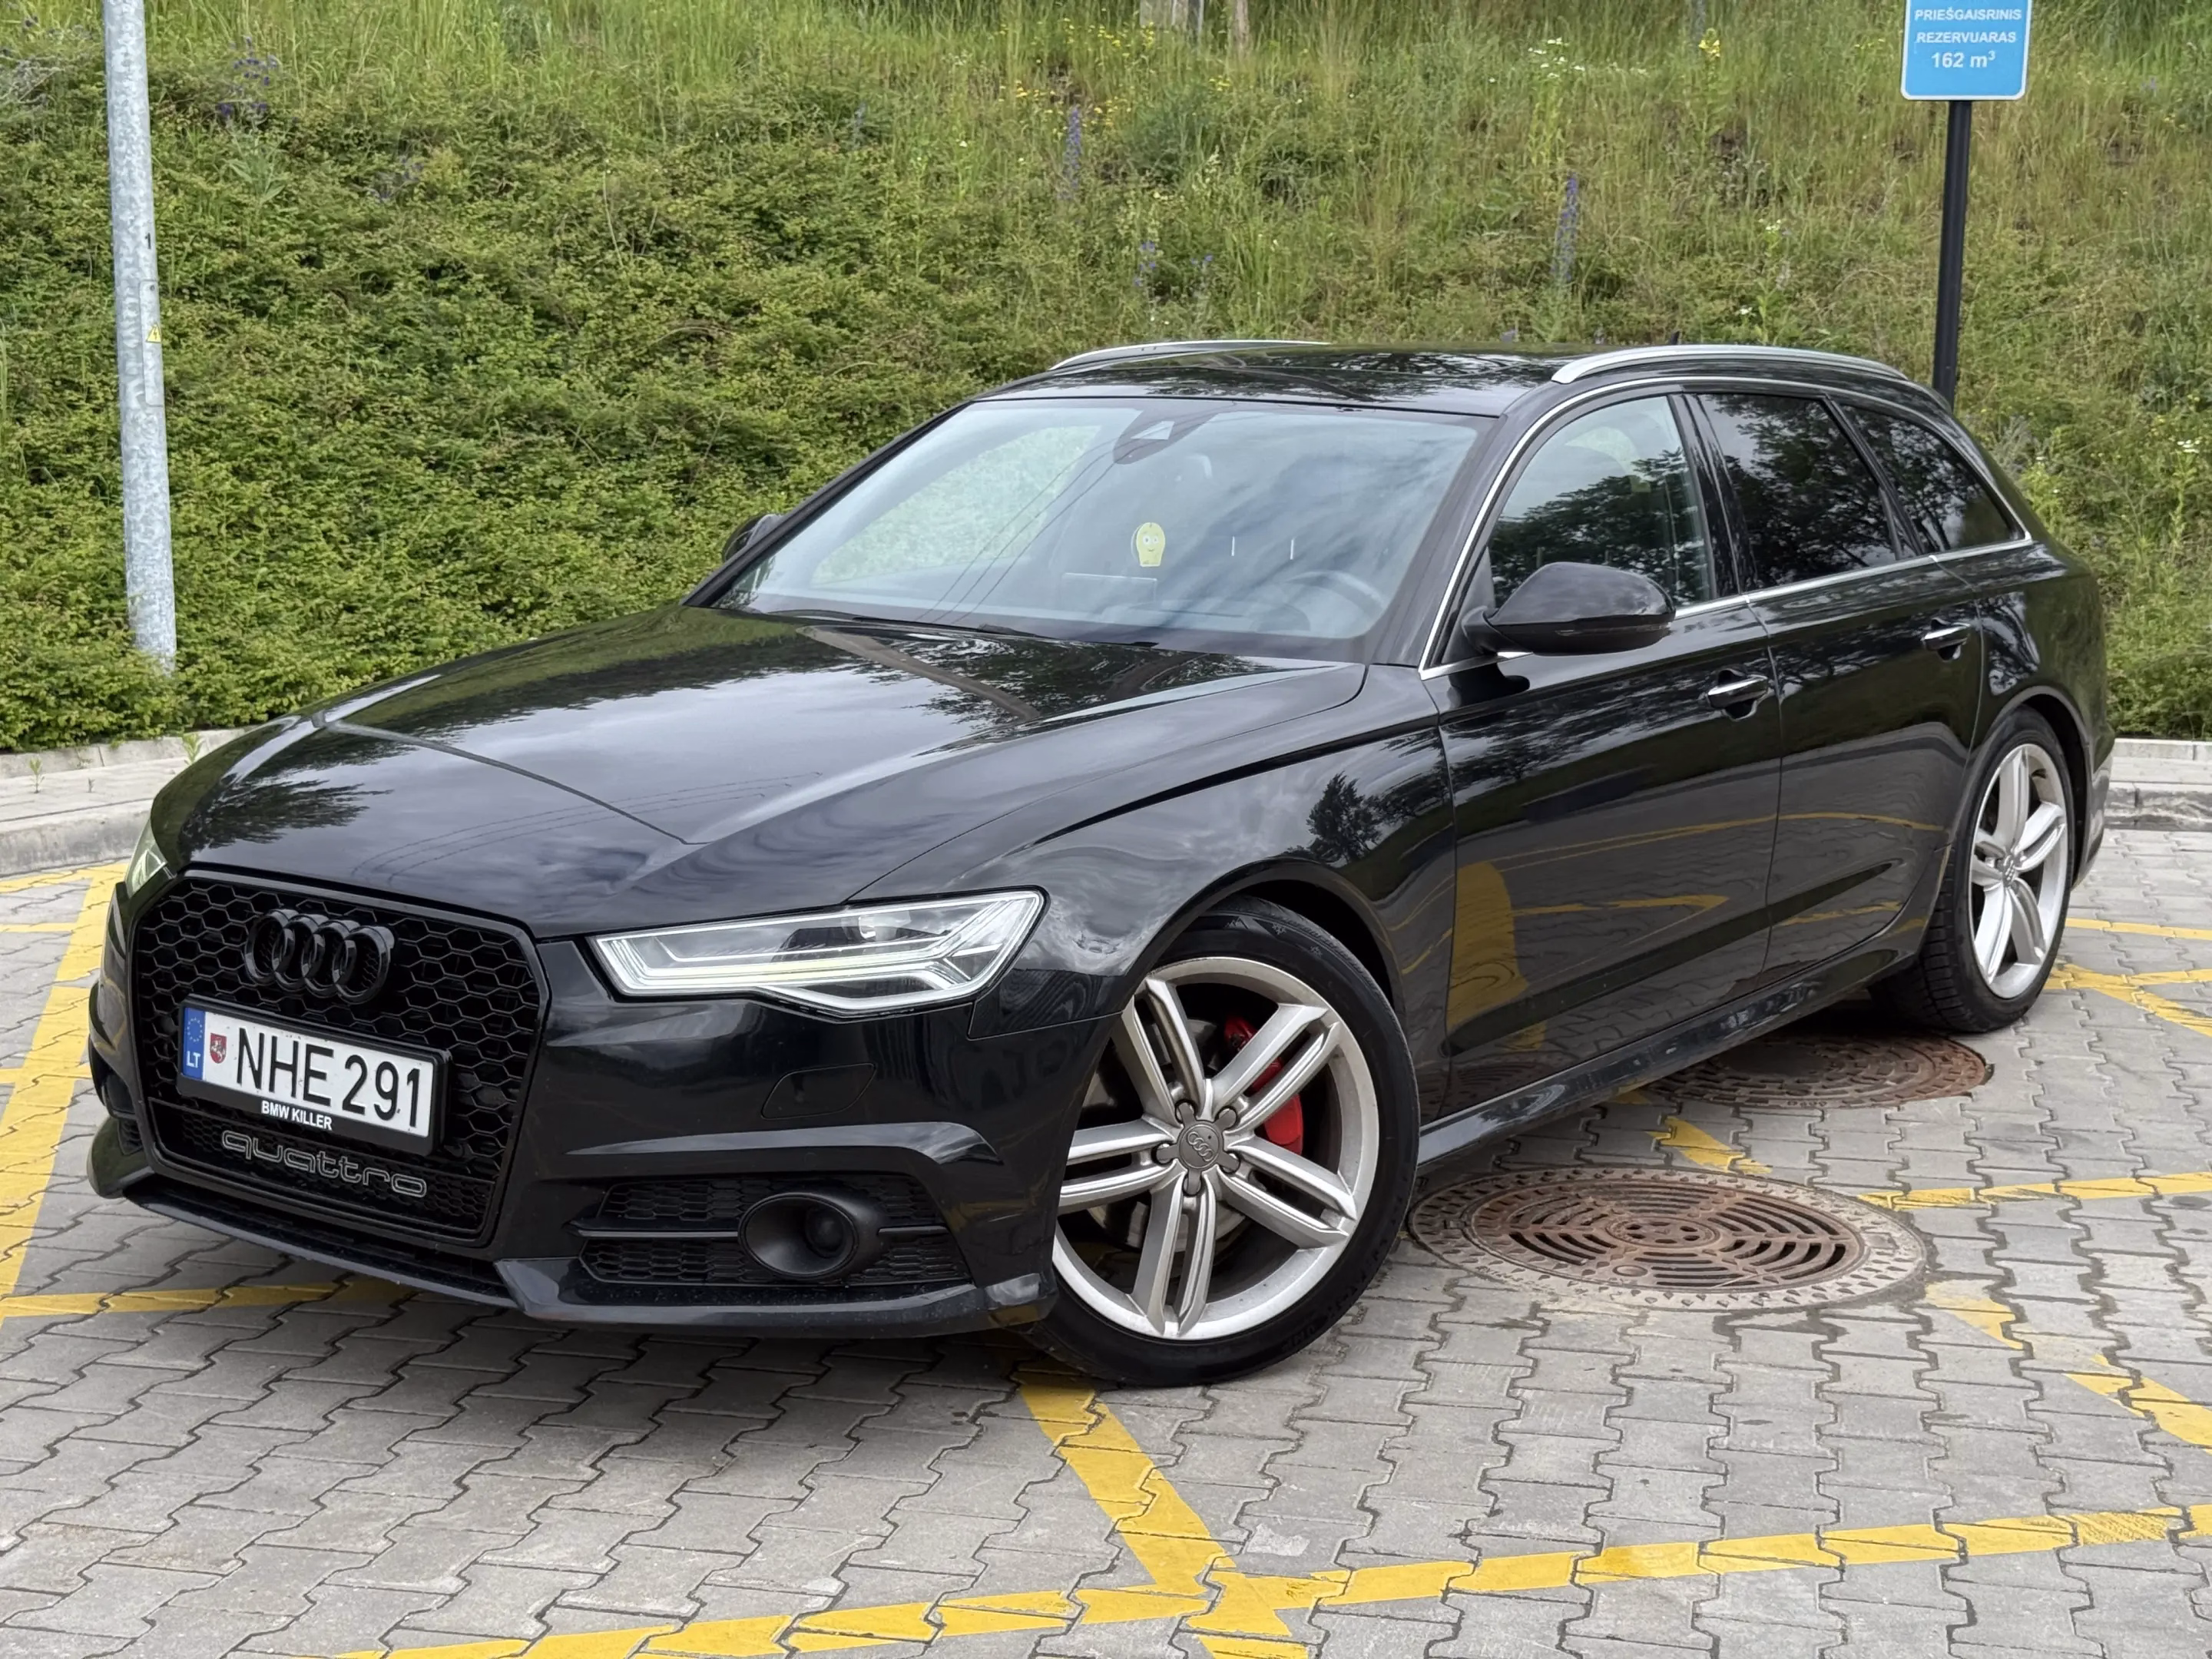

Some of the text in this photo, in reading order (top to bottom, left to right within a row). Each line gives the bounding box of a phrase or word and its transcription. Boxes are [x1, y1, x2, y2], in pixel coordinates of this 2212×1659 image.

[1914, 7, 2022, 21] PRIEŠGAISRINIS
[1916, 31, 2016, 44] REZERVUARAS
[1932, 52, 1964, 68] 162
[187, 1050, 201, 1068] LT
[261, 1100, 332, 1131] BMW KILLER
[221, 1130, 427, 1198] quattro
